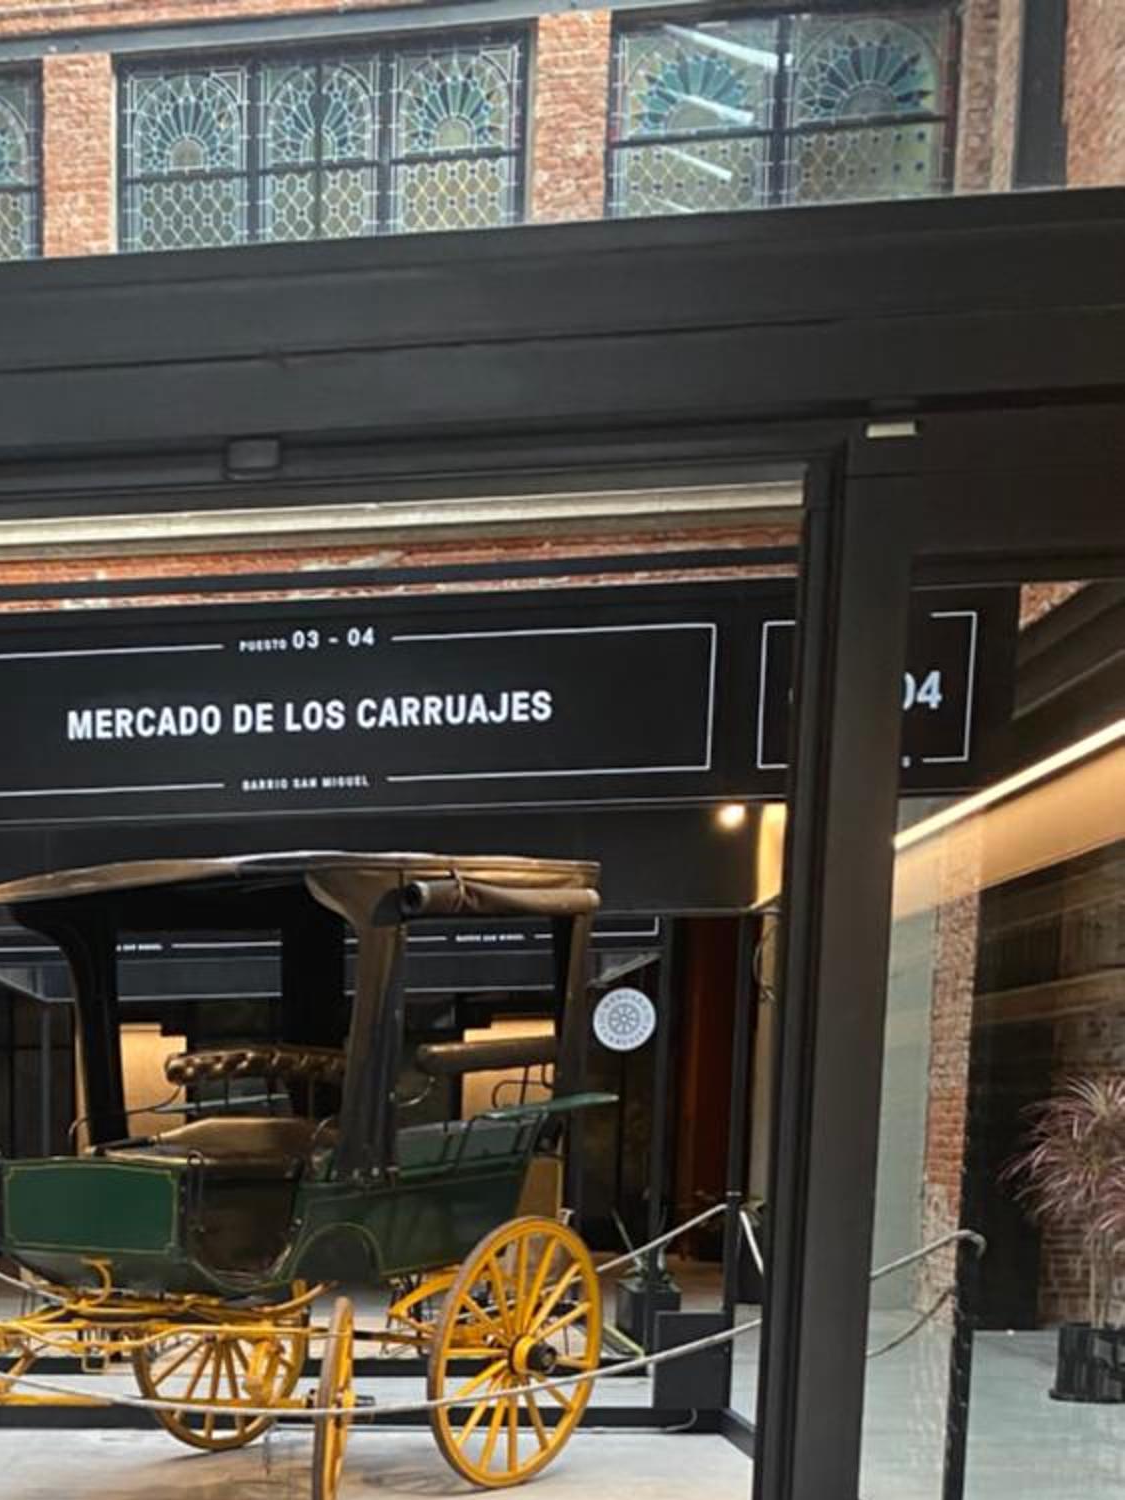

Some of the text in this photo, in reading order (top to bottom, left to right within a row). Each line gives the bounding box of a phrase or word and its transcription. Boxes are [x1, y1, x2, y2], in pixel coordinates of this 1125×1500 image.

[239, 638, 287, 651] PUESTO
[292, 629, 319, 649] 03
[347, 626, 374, 646] 04
[67, 690, 553, 740] MERCADO DE LOS CARRUAJES
